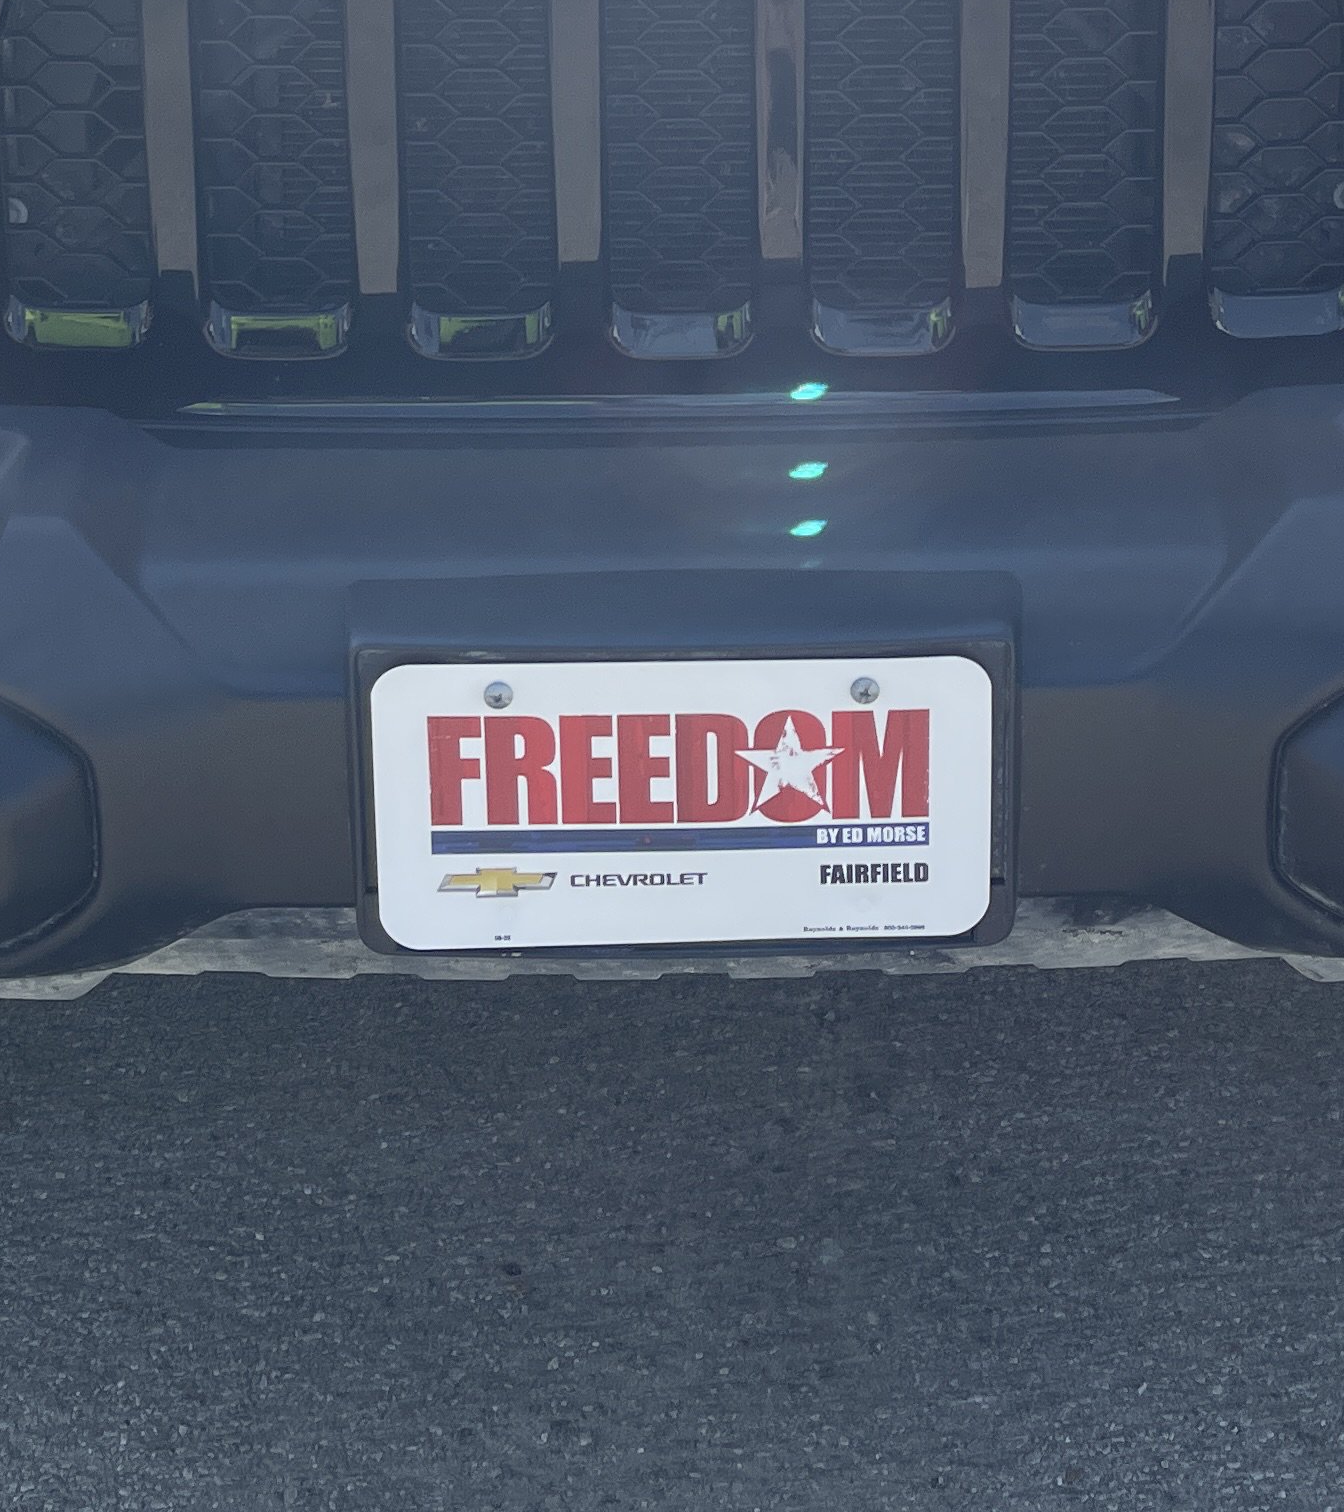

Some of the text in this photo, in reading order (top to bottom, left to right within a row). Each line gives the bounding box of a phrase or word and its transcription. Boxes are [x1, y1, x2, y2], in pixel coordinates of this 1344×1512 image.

[427, 709, 930, 826] FREEDOM
[816, 825, 926, 844] BY ED MORSE
[570, 872, 708, 887] CHEVROLET
[820, 862, 929, 885] FAIRFIELD
